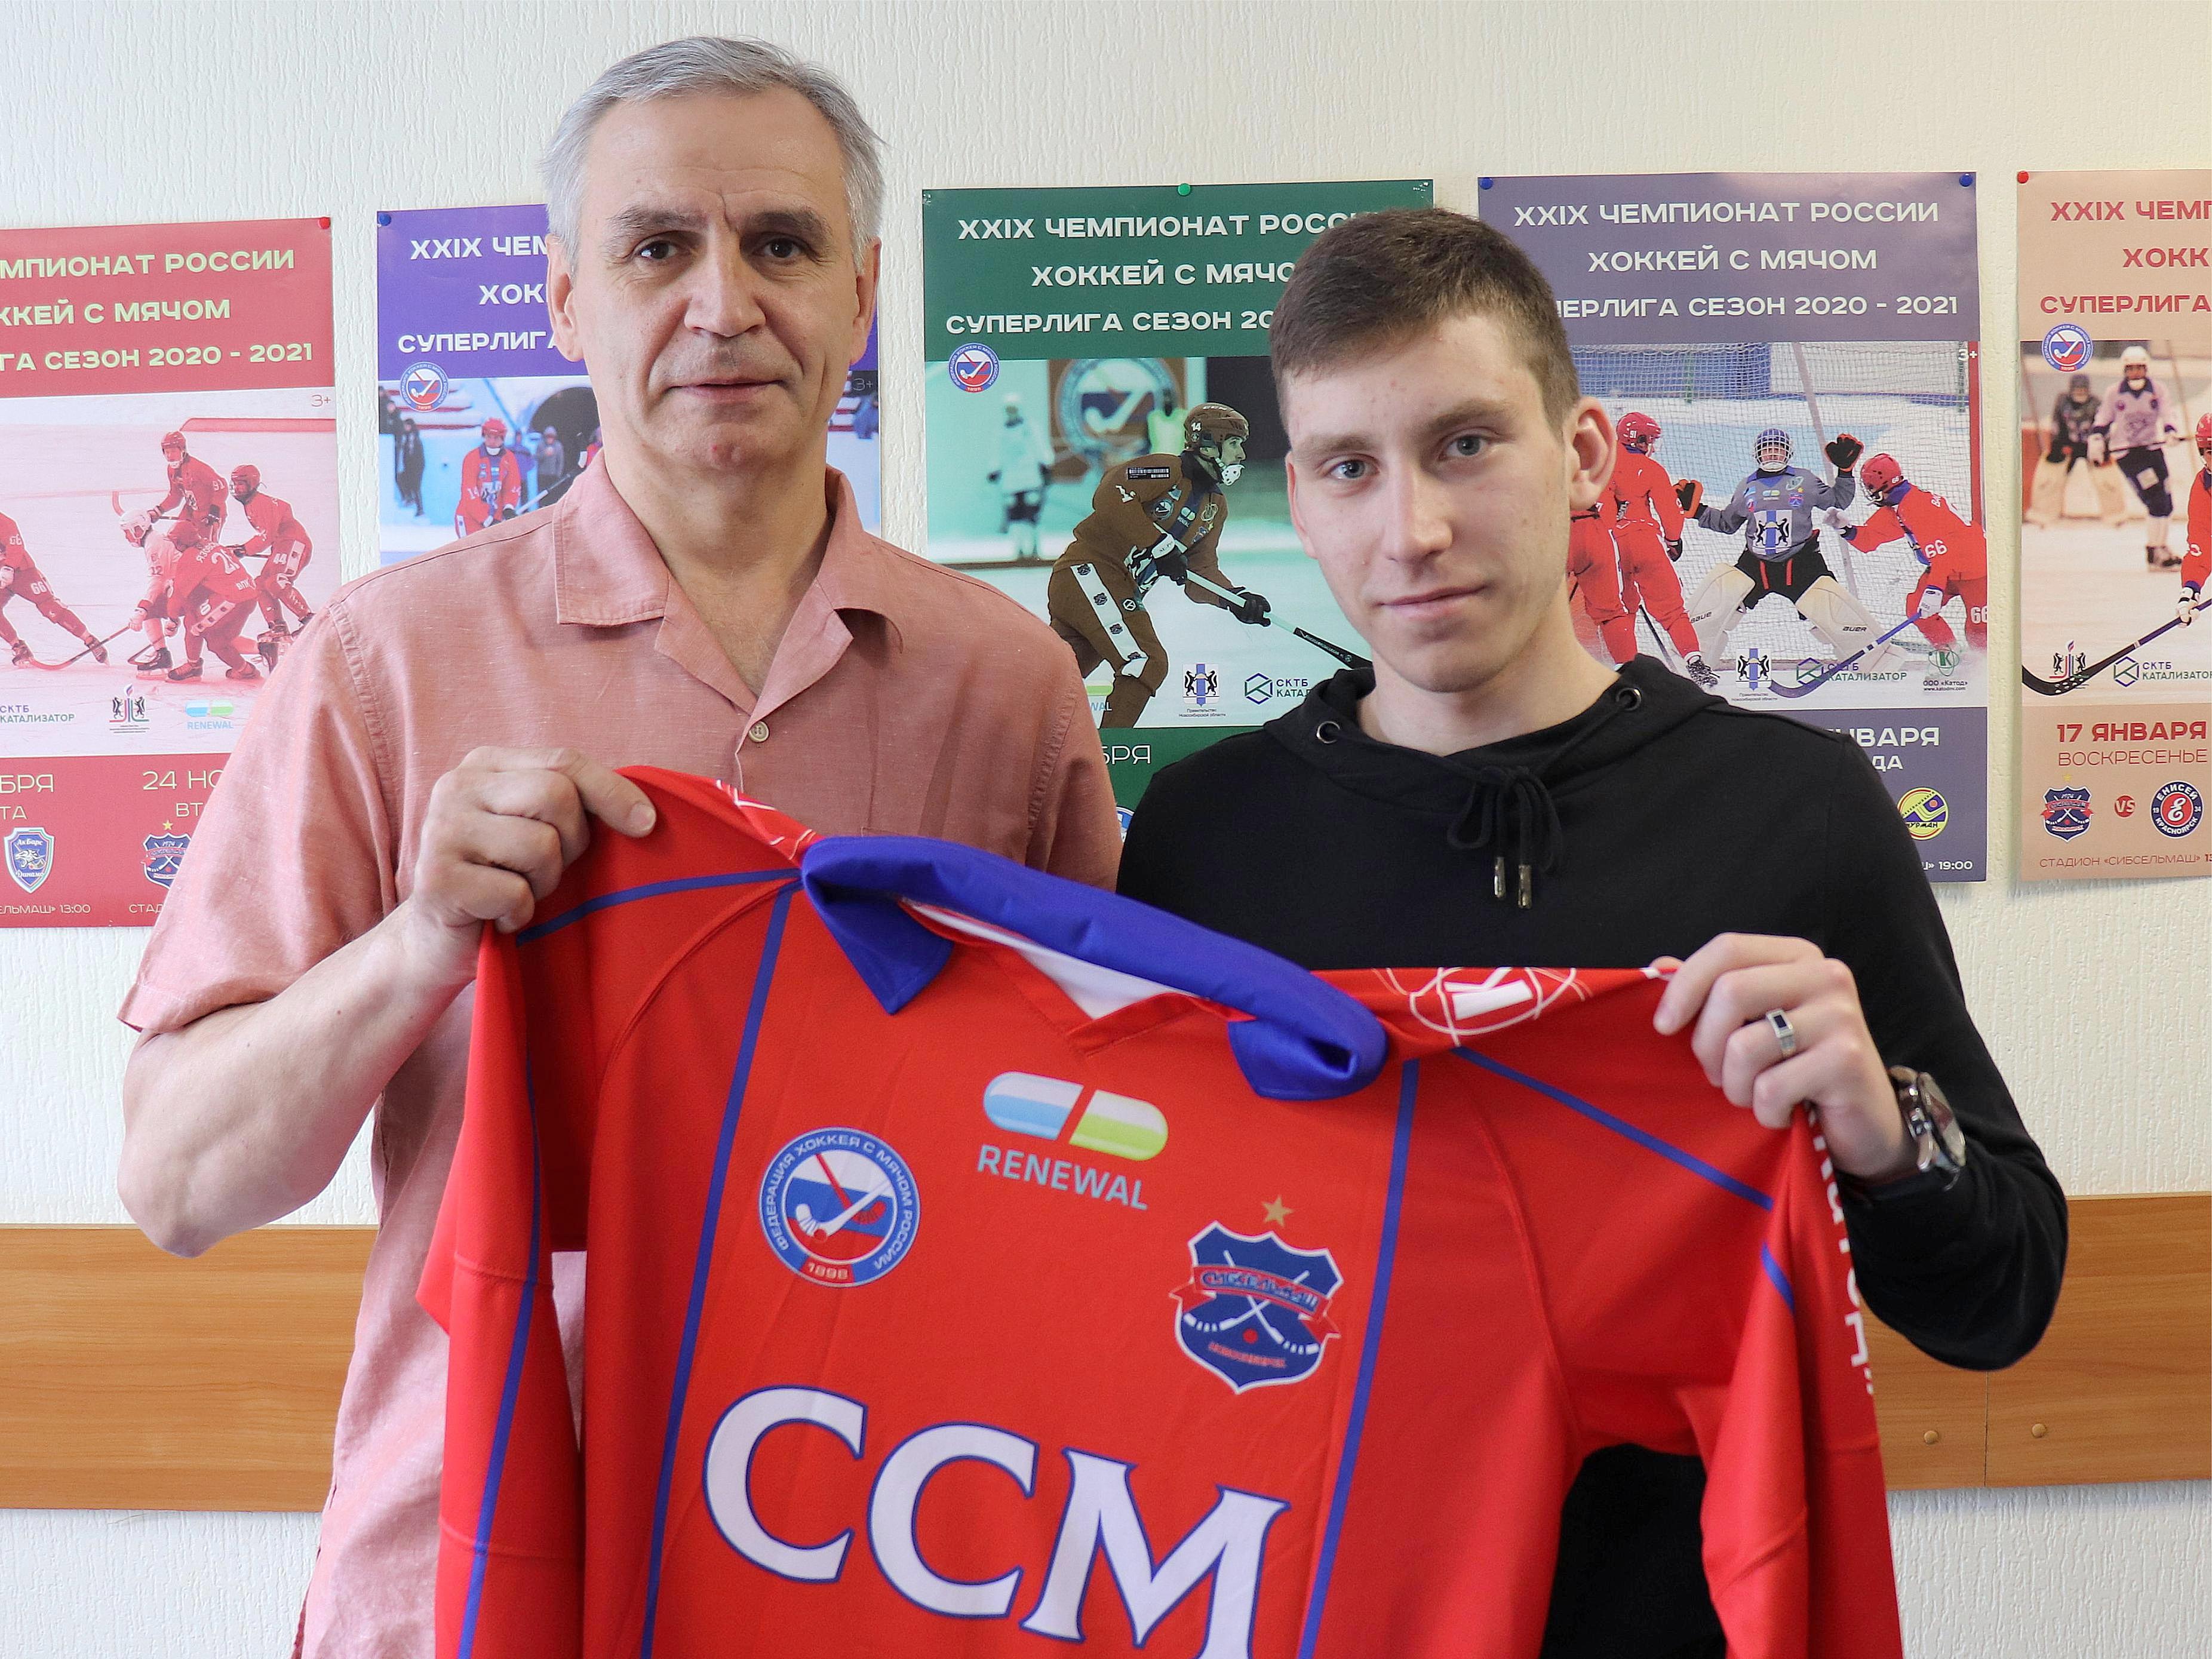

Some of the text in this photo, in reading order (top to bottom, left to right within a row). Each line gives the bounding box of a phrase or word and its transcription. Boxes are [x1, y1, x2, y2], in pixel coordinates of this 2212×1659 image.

[1514, 202, 1938, 226] XXIX ЧЕМПИОНАТ РОССИИ
[2051, 201, 2125, 221] XXIX
[958, 212, 1356, 240] XXIX ЧЕМПИОНАТ РОСС
[411, 238, 482, 260] XXIX
[1588, 244, 1877, 272] ХОККЕЙ С МЯЧОМ
[164, 250, 295, 273] РОССИИ
[1031, 257, 1164, 287] ХОККЕЙ
[1174, 264, 1196, 285] С
[479, 284, 548, 305] ХОК
[84, 303, 105, 324] С
[115, 299, 231, 323] МЯЧОМ
[1689, 297, 1786, 316] СЕЗОН
[1795, 297, 1867, 315] 2020
[1897, 297, 1958, 315] 2021
[2041, 295, 2212, 314] СУПЕРЛИГА
[945, 313, 1123, 334] СУПЕРЛИГА
[1132, 311, 1232, 331] СЕЗОН
[45, 348, 140, 371] СЕЗОН
[149, 346, 222, 367] 2020
[250, 343, 313, 362] 2021
[1958, 349, 1978, 361] 3+
[853, 378, 872, 391] 3+
[311, 395, 331, 407] 3+
[1191, 422, 1202, 431] 14
[1925, 539, 1947, 558] 66
[273, 553, 287, 565] 44
[30, 581, 47, 594] 66
[2143, 662, 2171, 670] СКТБ
[0, 714, 75, 723] КАТАЛИЗАТОР
[188, 721, 234, 730] RENEWAL
[1824, 727, 1940, 746] ВАРЯ
[2057, 721, 2207, 742] 17 ЯНВАРЯ
[2059, 749, 2208, 766] ВОСКРЕСЕНЬЕ
[143, 771, 177, 790] 24
[2157, 784, 2198, 801] ЕНИСЕЙ
[2155, 816, 2199, 835] КРАСНОЯРСК
[1938, 861, 1973, 870] 19:00
[2040, 858, 2100, 868] СТАДИОН
[2104, 854, 2200, 865] «СИБСЕЛЬМАШ»
[60, 904, 91, 914] 13:00
[863, 1141, 875, 1154] С
[876, 1150, 913, 1208] МЯЧОМ
[977, 1144, 1148, 1211] RENEWAL
[766, 1153, 796, 1251] ФЕДЕРАЦИЯ
[874, 1210, 913, 1270] РОССИИ
[702, 1384, 1291, 1659] CCM
